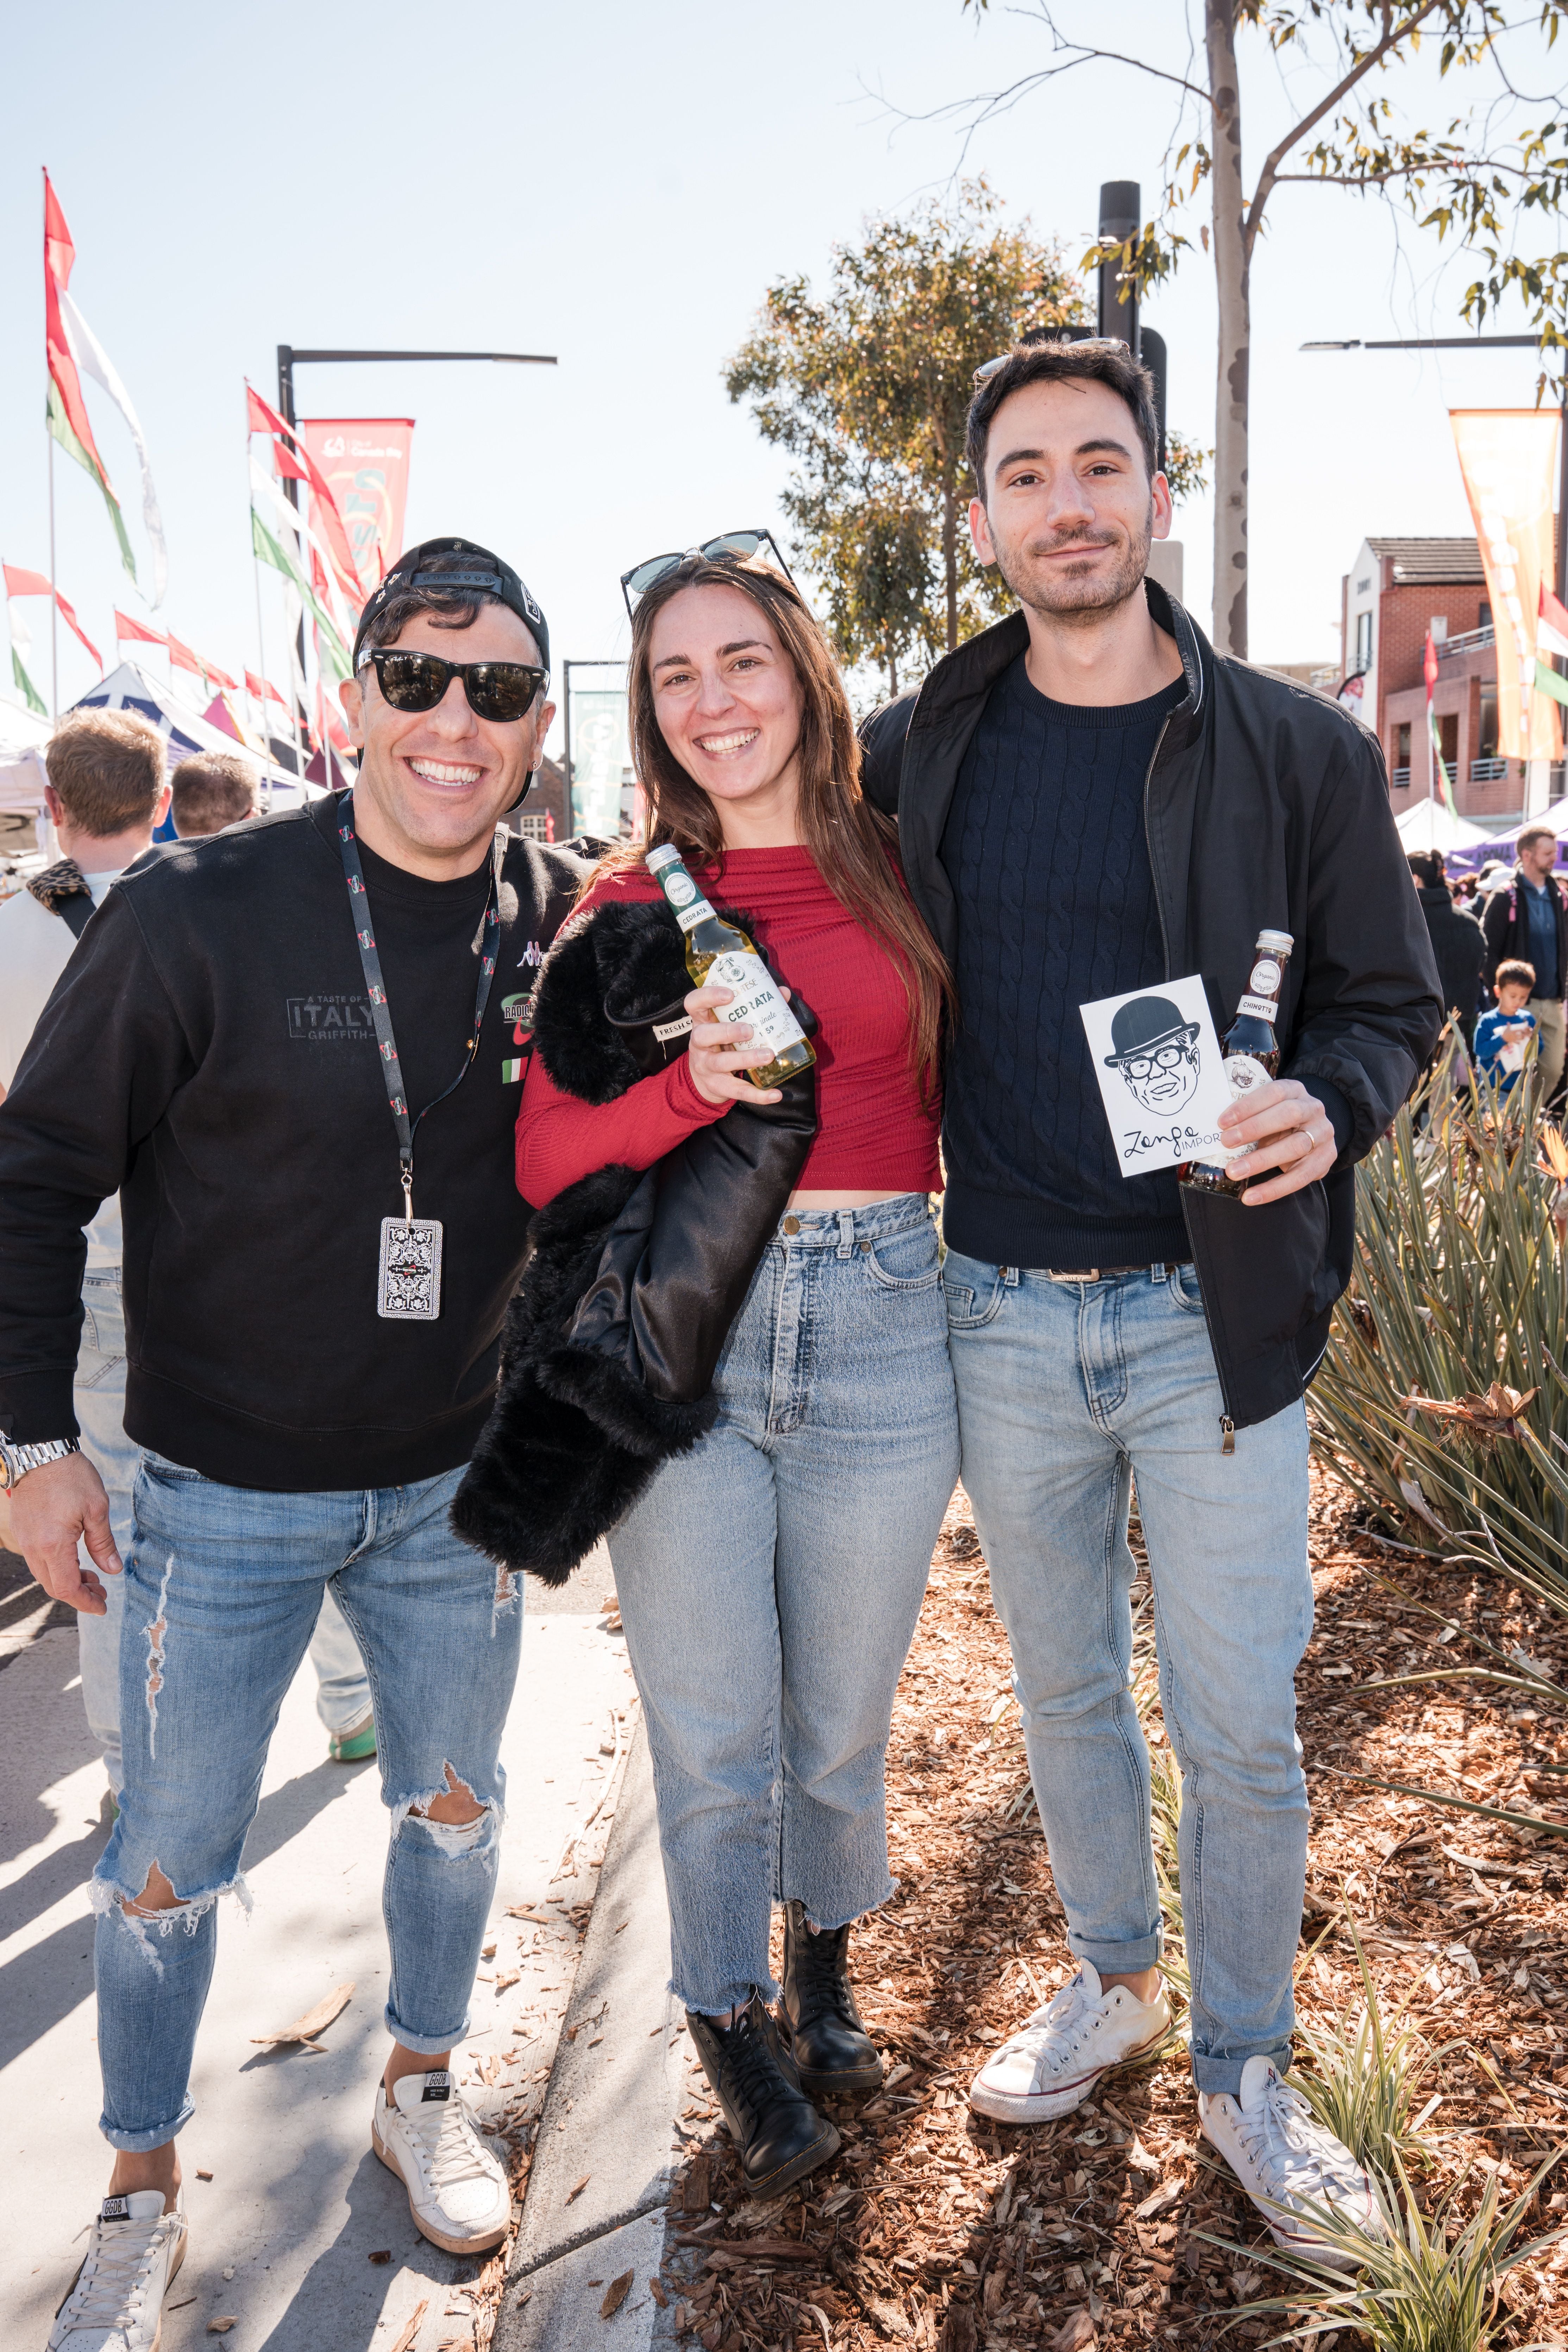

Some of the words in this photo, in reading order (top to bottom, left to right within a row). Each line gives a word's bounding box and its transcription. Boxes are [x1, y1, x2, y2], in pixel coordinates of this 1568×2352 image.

[671, 883, 688, 895] Organic
[683, 908, 708, 924] CEDRATA
[1256, 971, 1275, 980] Organic
[733, 978, 758, 997] ORTESE
[504, 1004, 529, 1018] RADIO
[728, 991, 774, 1022] CEDRATA
[1243, 1002, 1272, 1014] CHINOTTO
[294, 1005, 373, 1027] ITALY
[308, 1030, 367, 1039] GRIFFITH
[659, 1023, 685, 1035] FRESH
[759, 1025, 774, 1037] 159
[429, 2074, 446, 2086] GGDB
[105, 2200, 122, 2214] GGDB
